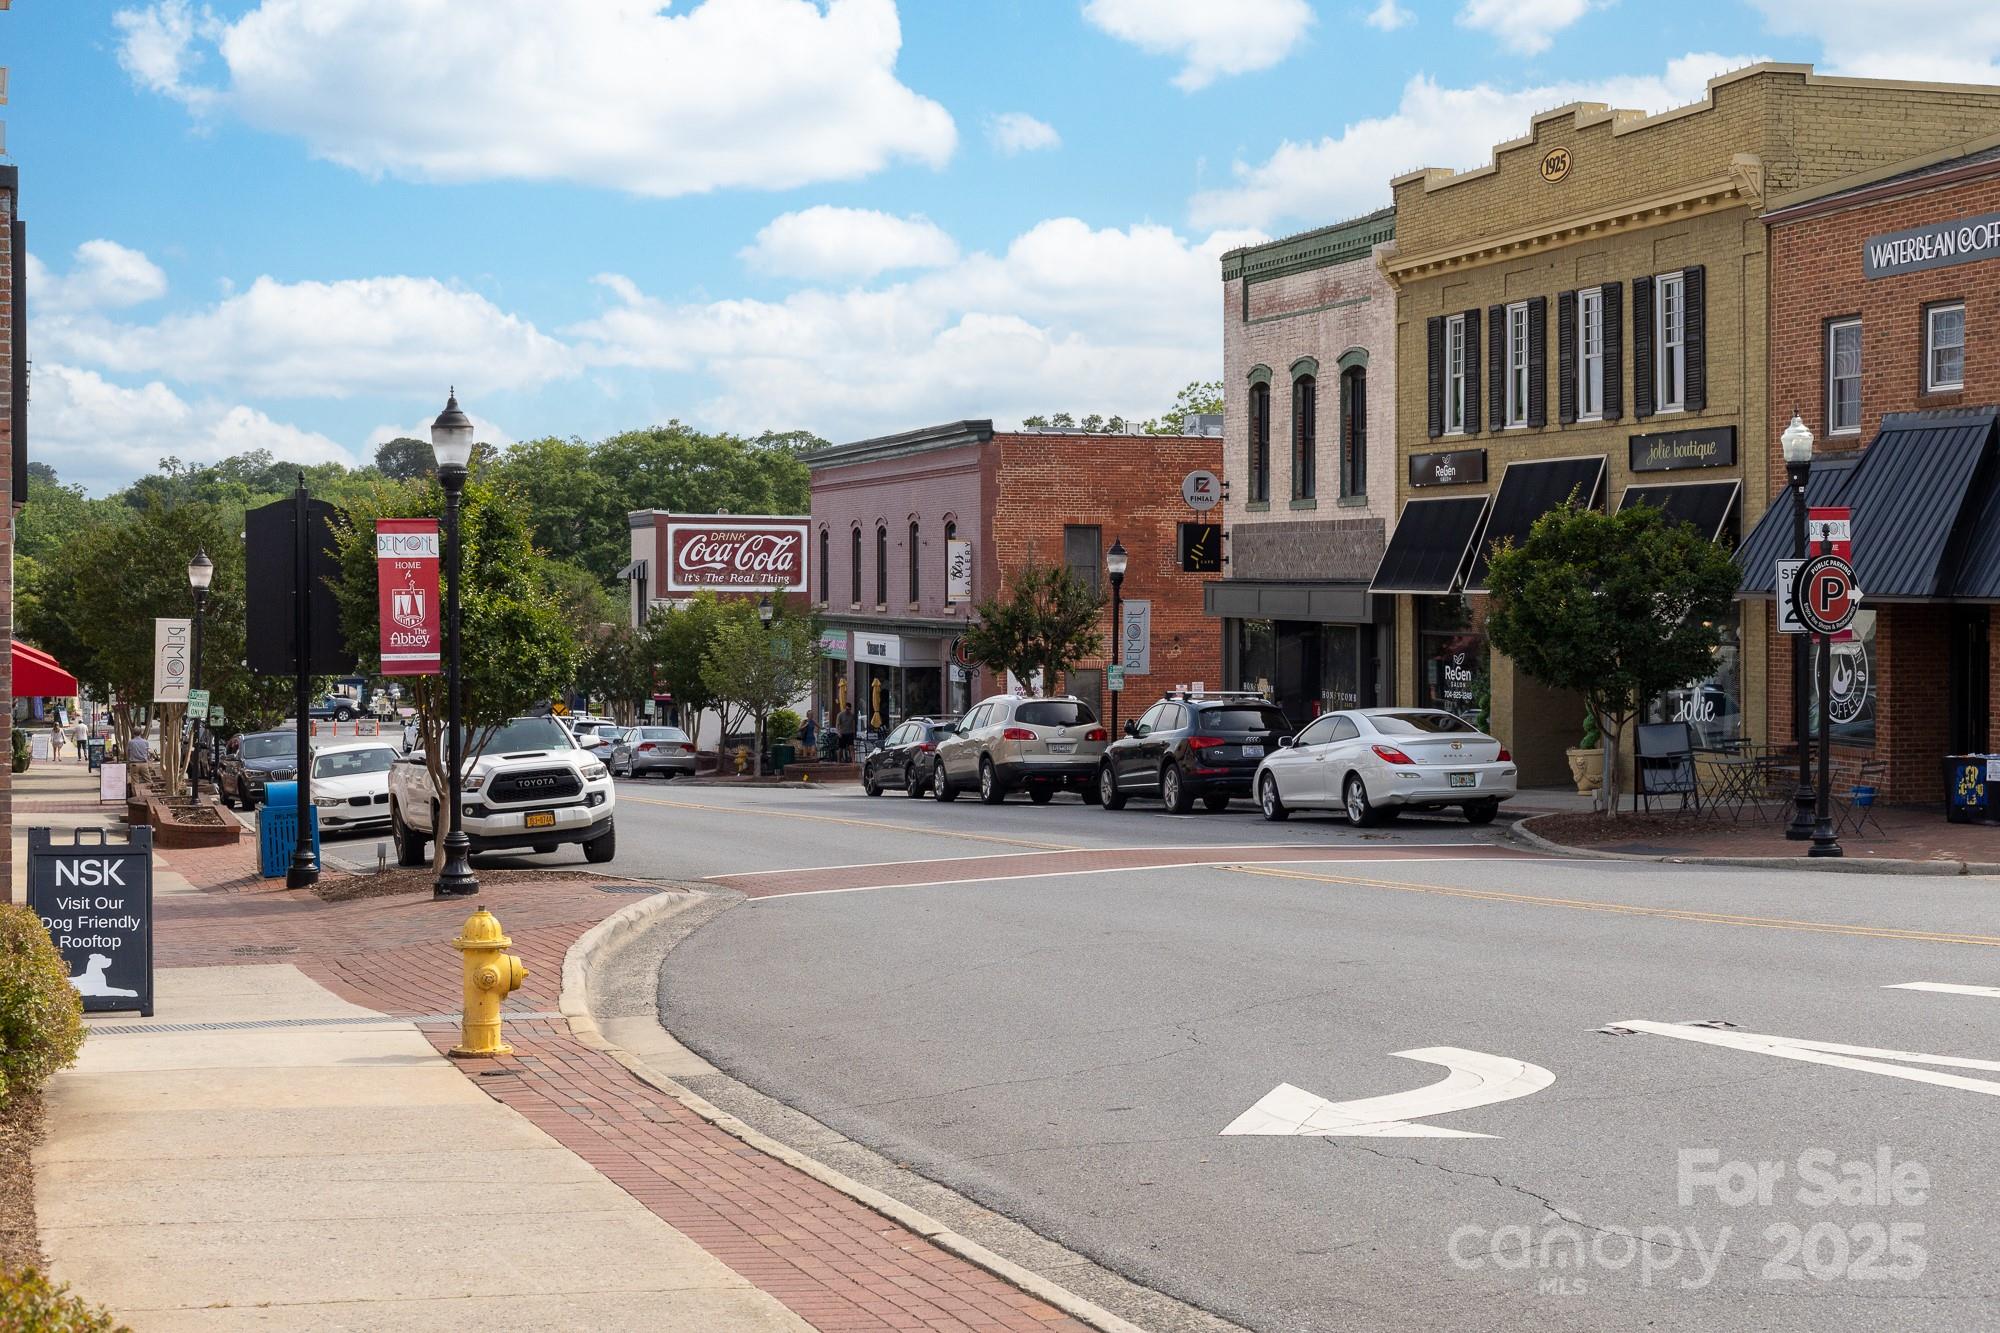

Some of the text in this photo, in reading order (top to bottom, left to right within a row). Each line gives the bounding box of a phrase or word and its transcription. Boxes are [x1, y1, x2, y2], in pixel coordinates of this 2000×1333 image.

[1545, 153, 1567, 176] 1925
[1870, 230, 1956, 269] WATERBEAN
[1646, 439, 1717, 465] jolie boutique
[1435, 464, 1456, 477] ReGen
[711, 532, 747, 541] DRINK
[679, 534, 798, 571] Coca-Cola
[395, 561, 421, 569] HOME
[964, 542, 972, 594] GALLERY
[1811, 559, 1829, 575] PUBLIC
[1830, 559, 1852, 576] PARKING
[684, 573, 790, 585] It's The Real Thing
[1820, 576, 1846, 612] P
[1803, 602, 1812, 618] Enjoy
[1817, 621, 1831, 631] Shops
[390, 632, 430, 647] Abbey
[1444, 665, 1472, 681] ReGen
[190, 700, 207, 708] PARKING
[190, 708, 204, 716] ONLY
[1672, 686, 1716, 722] jolie
[1829, 693, 1861, 718] OFFEE
[518, 777, 555, 788] TOYOTA
[55, 859, 126, 887] NSK
[56, 897, 124, 910] Visit Our
[41, 915, 141, 932] Dog Friendly
[59, 935, 122, 950] Rooftop
